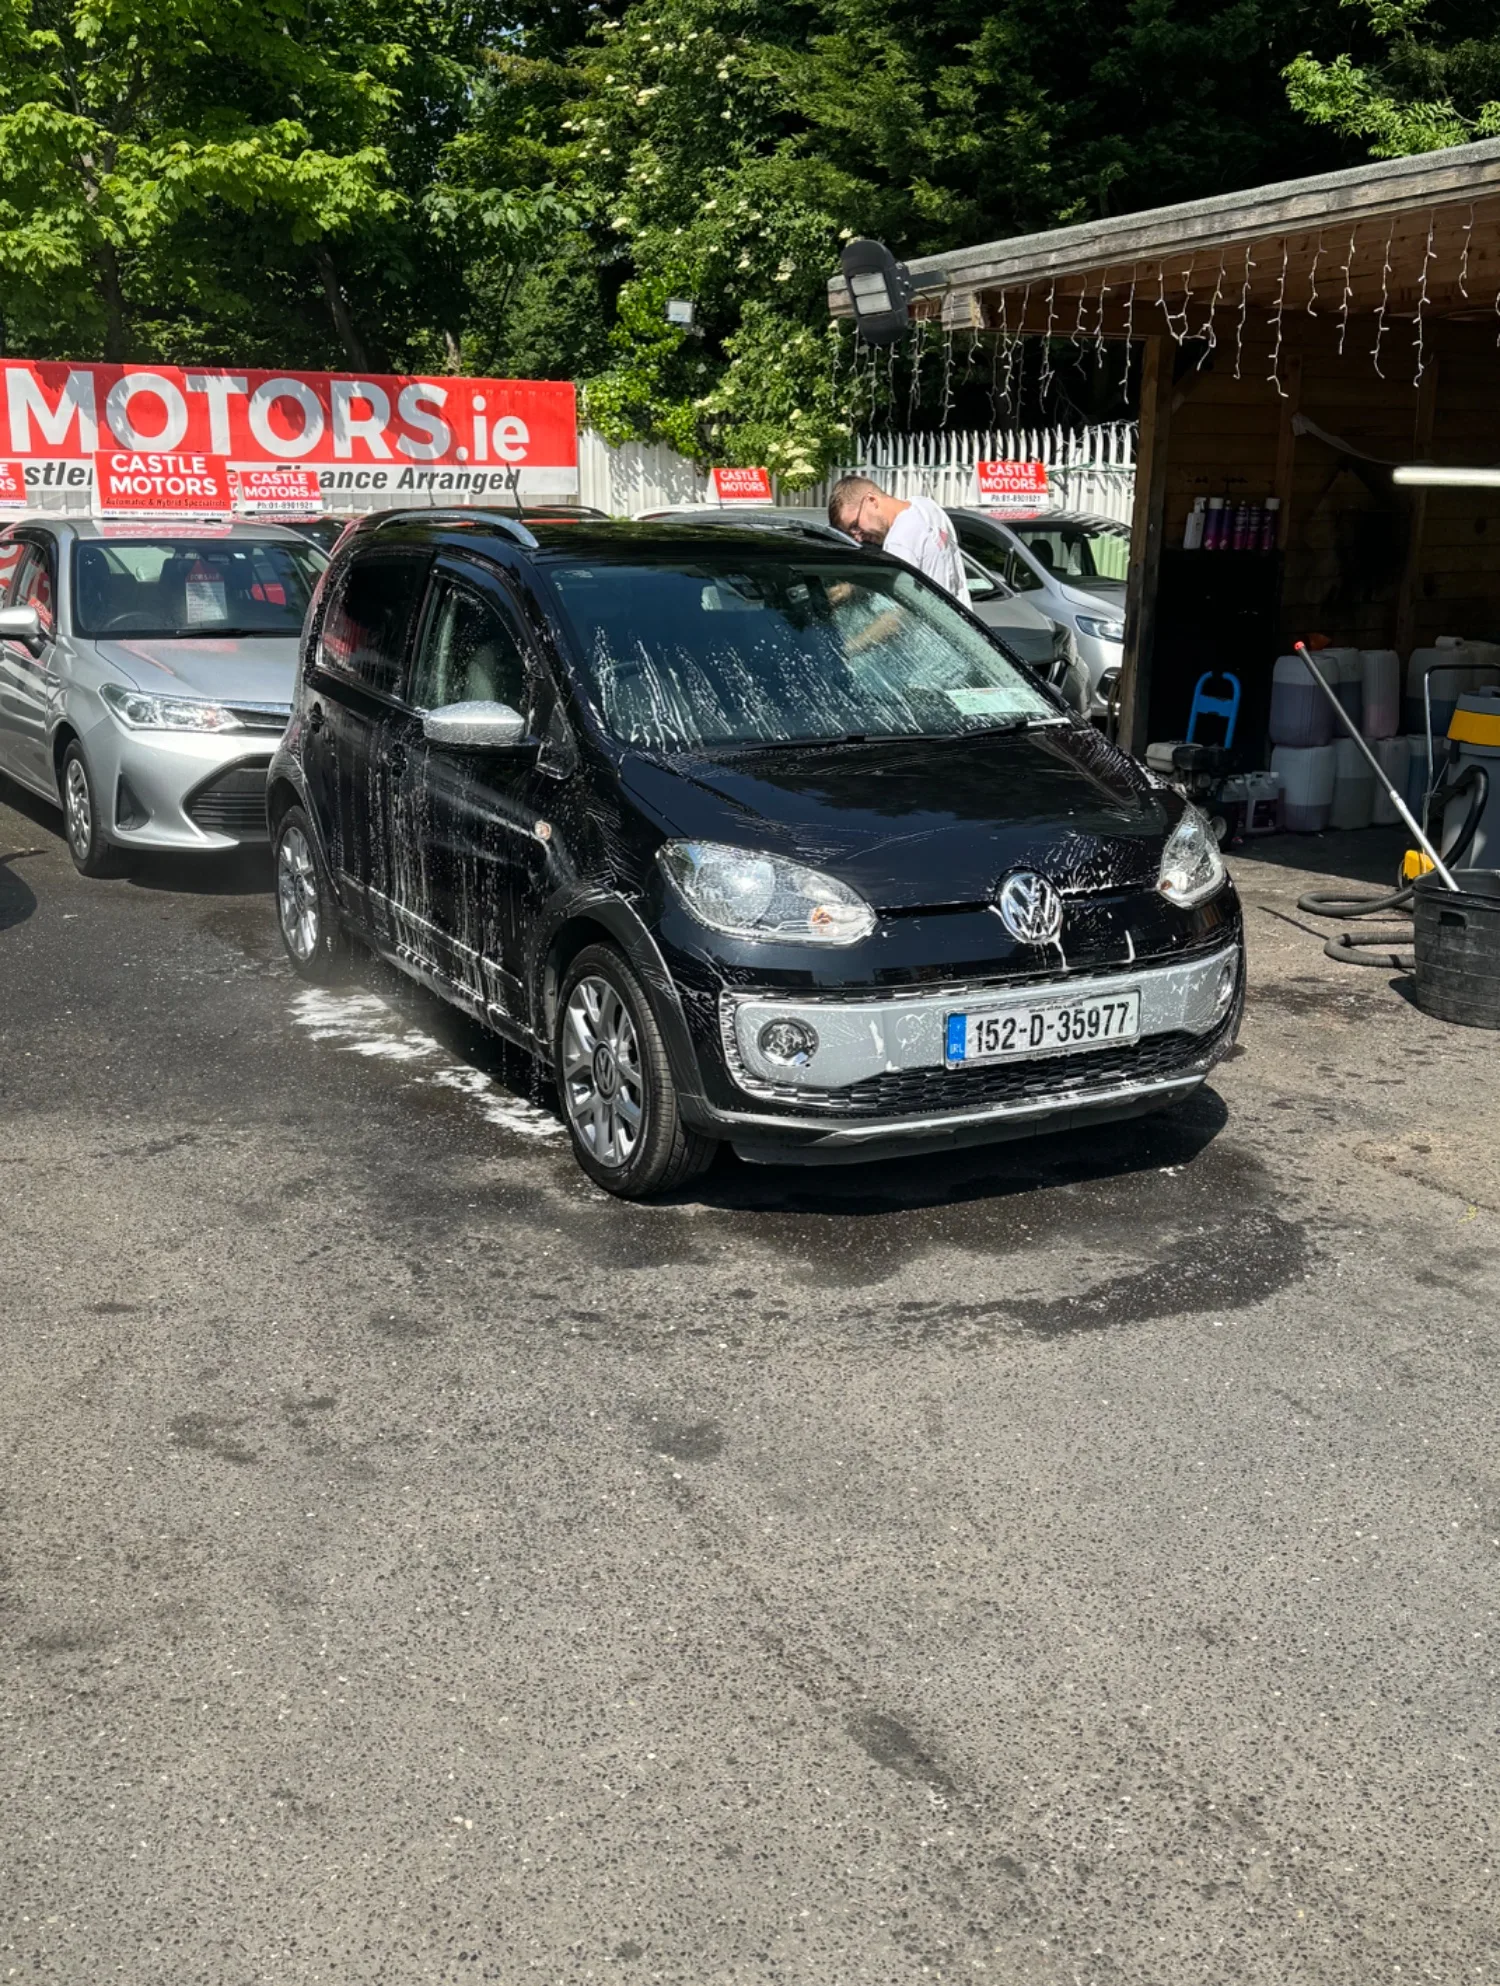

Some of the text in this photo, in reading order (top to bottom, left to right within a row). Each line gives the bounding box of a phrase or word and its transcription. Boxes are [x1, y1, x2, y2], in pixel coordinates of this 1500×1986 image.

[5, 367, 530, 462] MOTORS.ie
[111, 454, 207, 474] CASTLE
[987, 464, 1037, 476] CASTLE
[24, 462, 93, 486] stle
[250, 473, 308, 484] CASTLE
[397, 467, 520, 494] Arranged
[720, 471, 760, 481] CASTLE
[110, 476, 218, 496] MOTORS
[244, 486, 320, 498] MOTORS.ie
[721, 482, 766, 492] MOTORS
[106, 498, 145, 506] Automatic
[148, 498, 154, 506] &
[156, 498, 182, 508] Hybrid
[975, 1002, 1130, 1053] 152-D-35977
